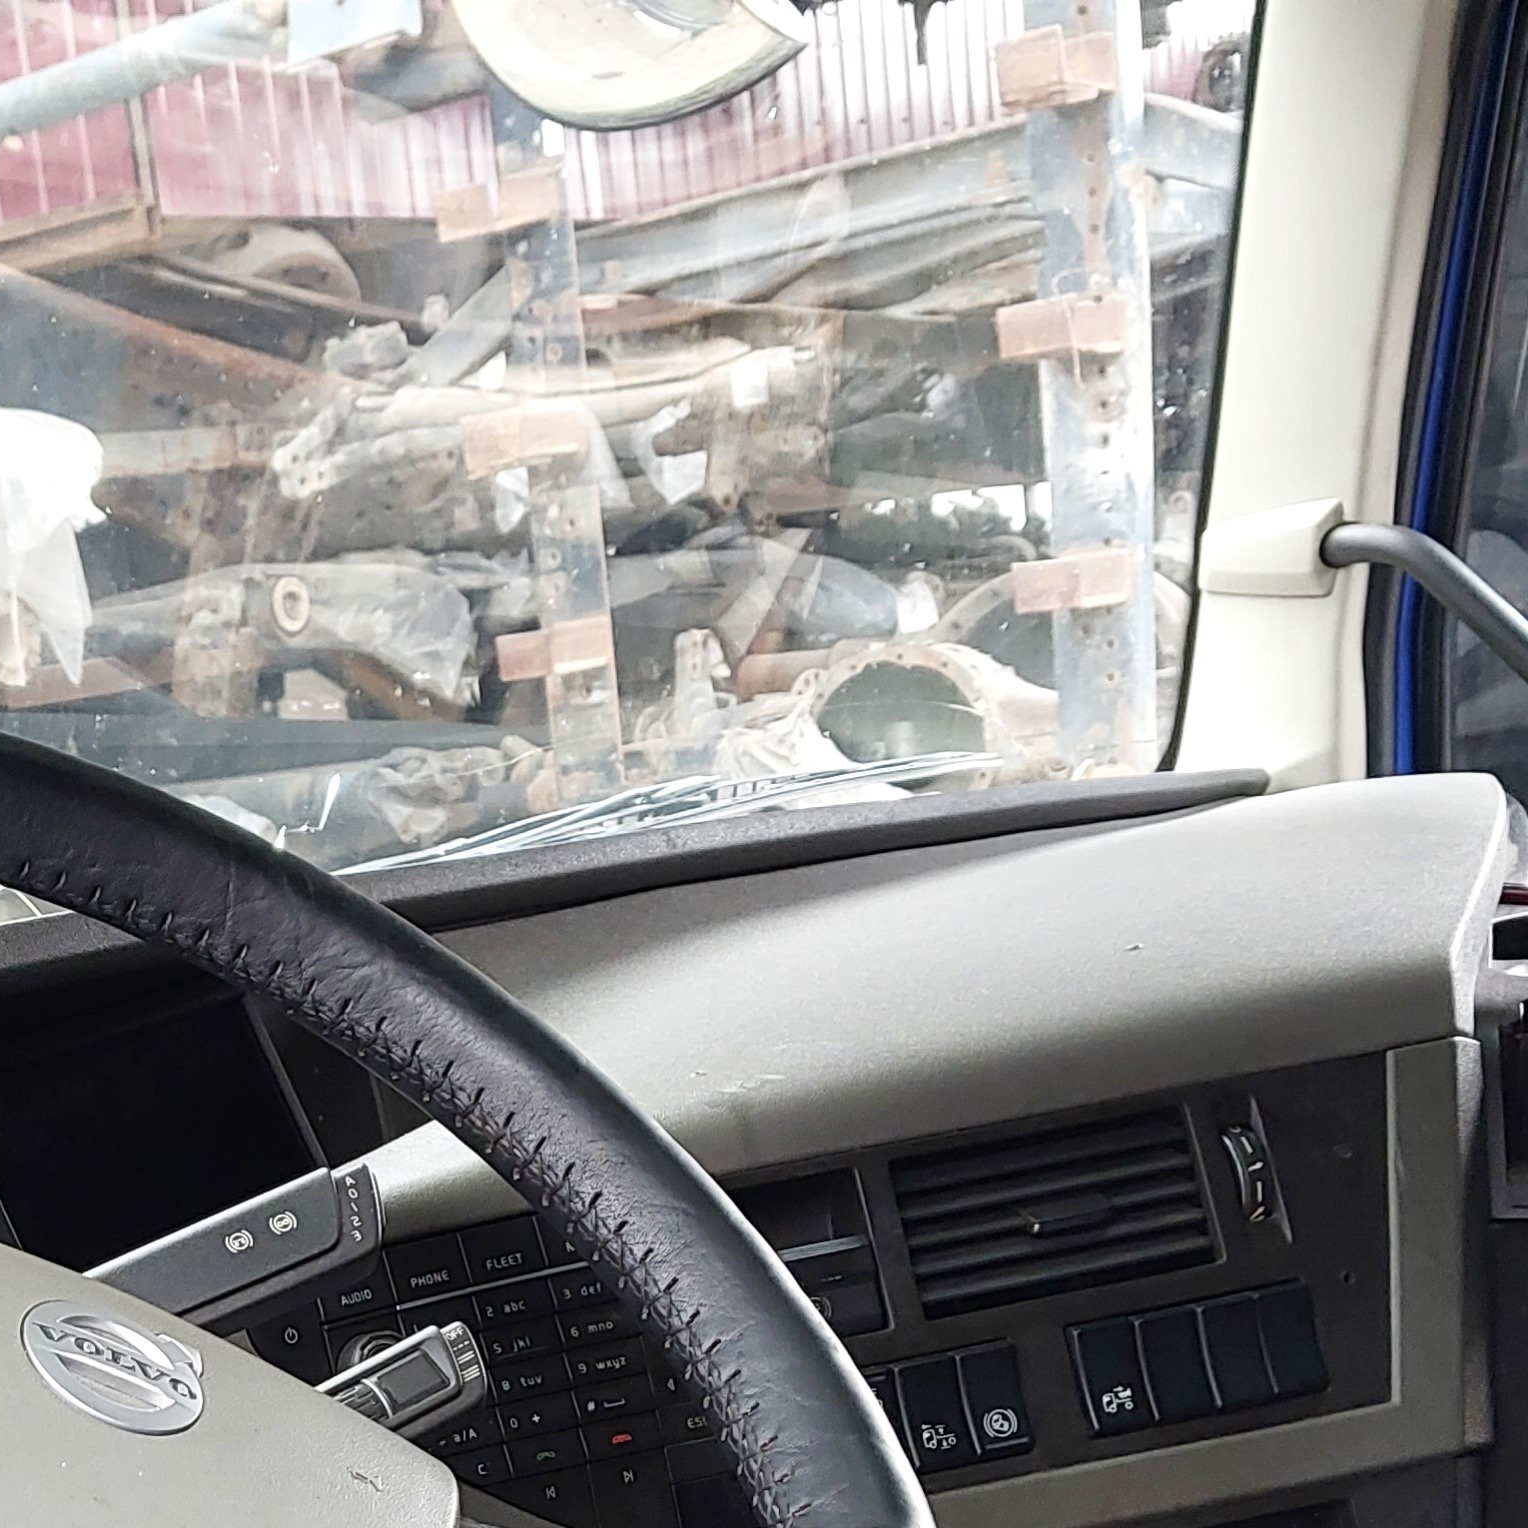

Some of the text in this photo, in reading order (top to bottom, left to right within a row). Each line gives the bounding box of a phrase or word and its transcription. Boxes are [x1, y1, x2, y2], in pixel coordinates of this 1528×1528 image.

[486, 1253, 523, 1271] FLEET
[410, 1269, 451, 1289] PHONE
[341, 1288, 372, 1307] AUDIO
[562, 1282, 602, 1299] 3 def
[486, 1299, 526, 1318] 2 abc
[445, 1326, 465, 1341] OFF
[570, 1320, 614, 1338] 6 mno
[493, 1336, 532, 1354] 5 jkl
[32, 1321, 198, 1400] VOLVO
[578, 1356, 628, 1374] 9 wxyz
[501, 1374, 543, 1391] 8 tuv
[509, 1418, 519, 1428] 0
[477, 1463, 488, 1475] C
